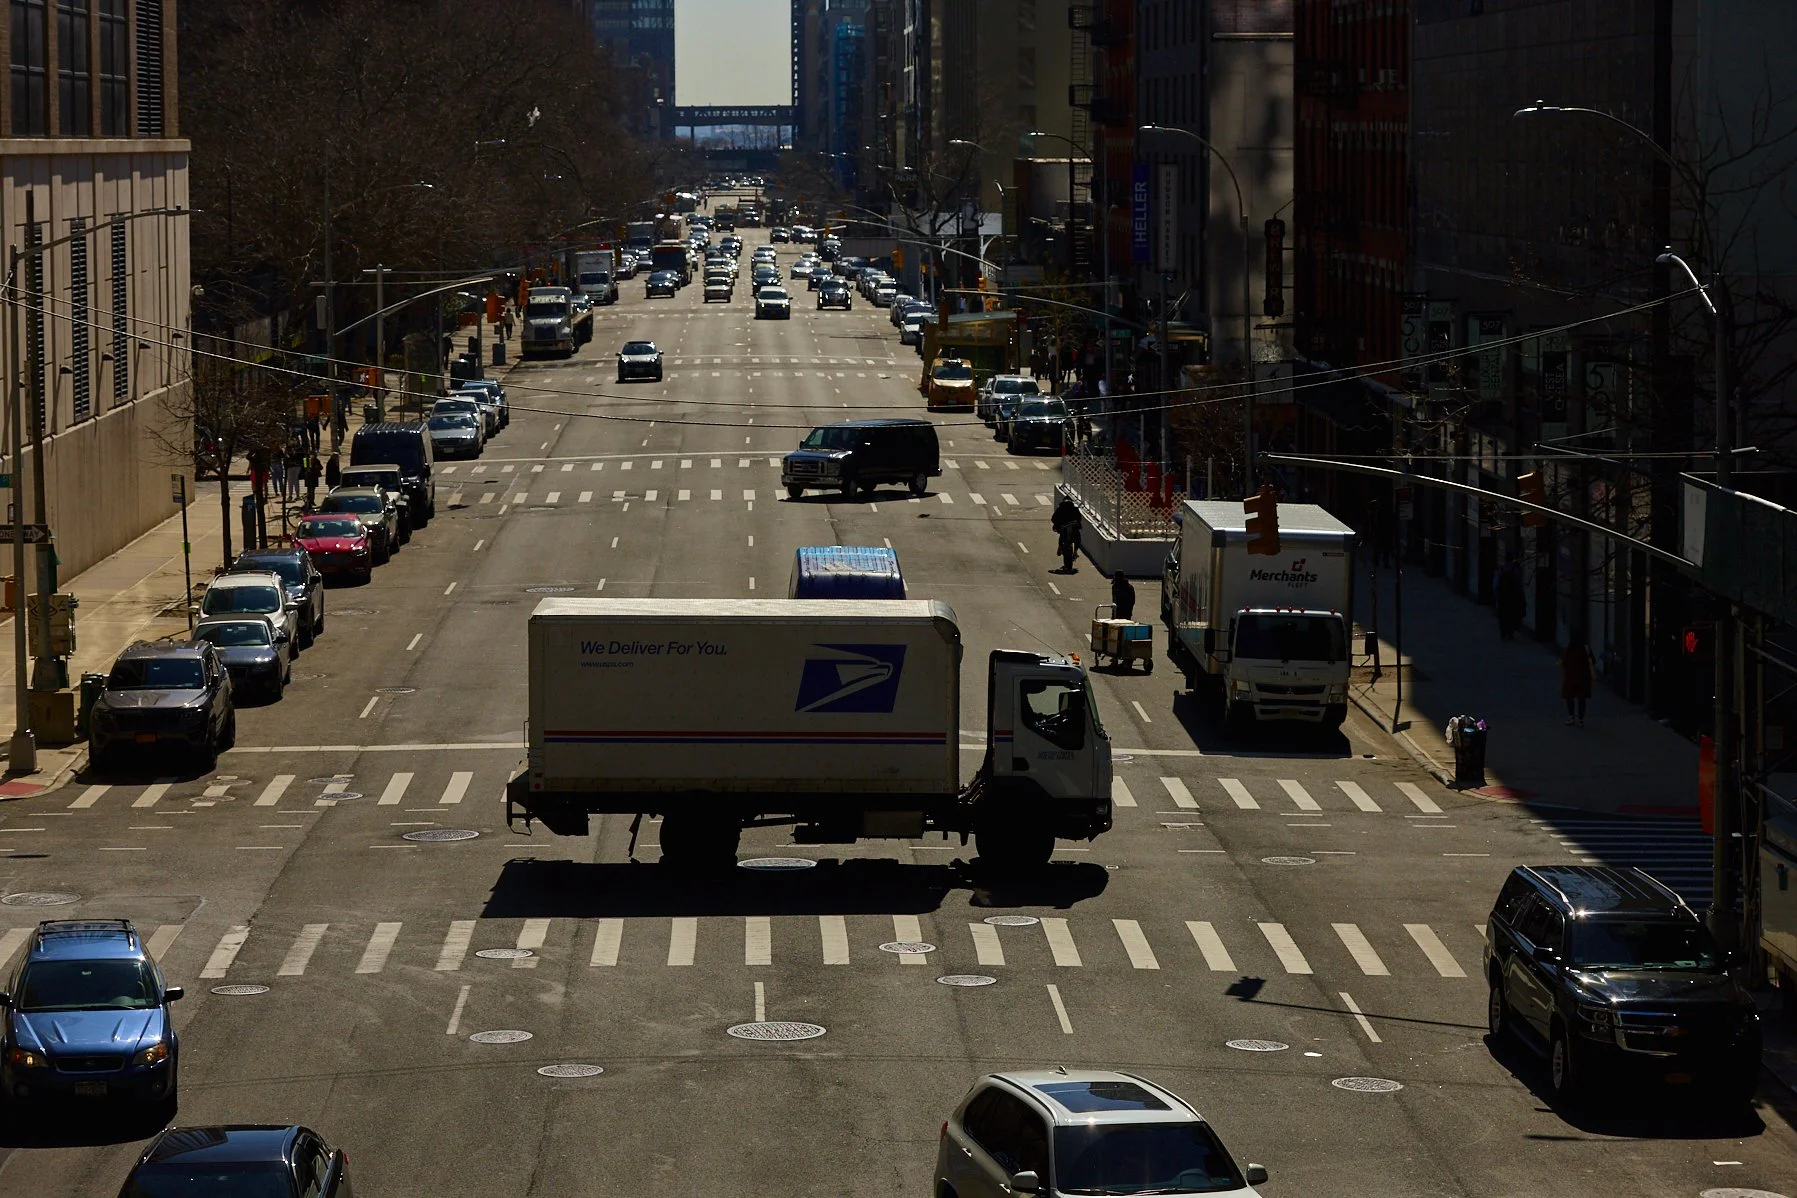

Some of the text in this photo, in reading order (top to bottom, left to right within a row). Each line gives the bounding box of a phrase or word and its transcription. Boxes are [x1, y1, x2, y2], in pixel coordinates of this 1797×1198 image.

[1134, 181, 1147, 242] HELLER
[1480, 320, 1501, 331] 507
[1250, 569, 1317, 582] Merchants
[581, 641, 727, 655] We Deliver For You.
